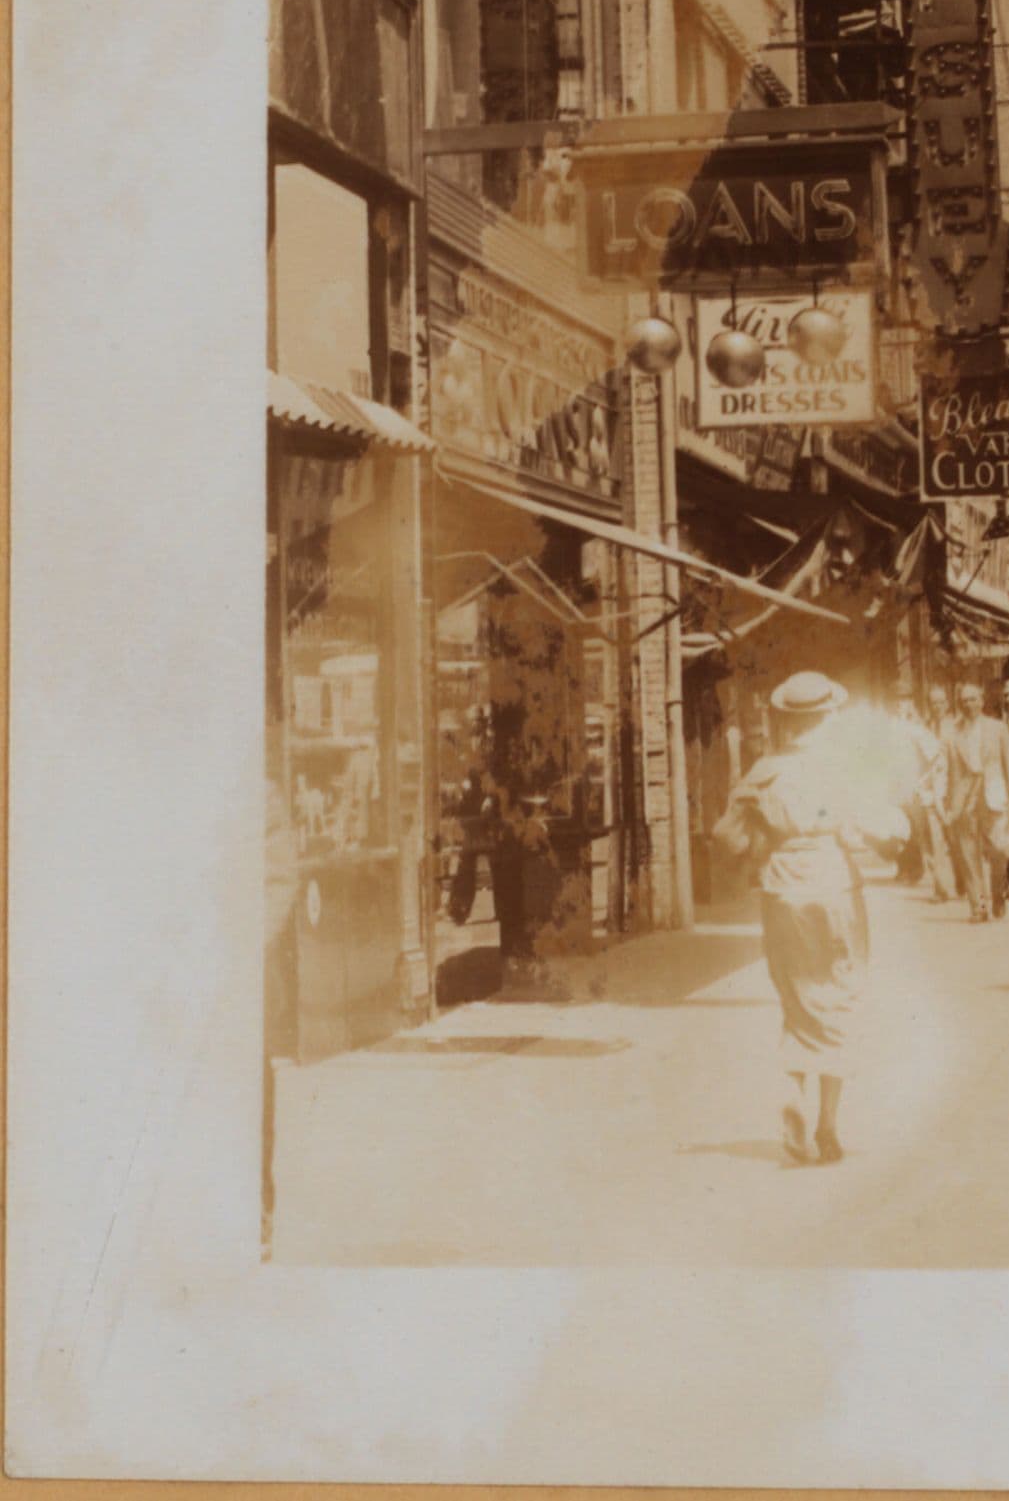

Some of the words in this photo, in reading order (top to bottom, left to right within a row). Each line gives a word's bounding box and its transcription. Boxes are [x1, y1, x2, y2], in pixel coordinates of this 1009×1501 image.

[917, 43, 989, 306] SUEY
[603, 178, 856, 254] LOANS
[720, 388, 847, 415] DRESSES
